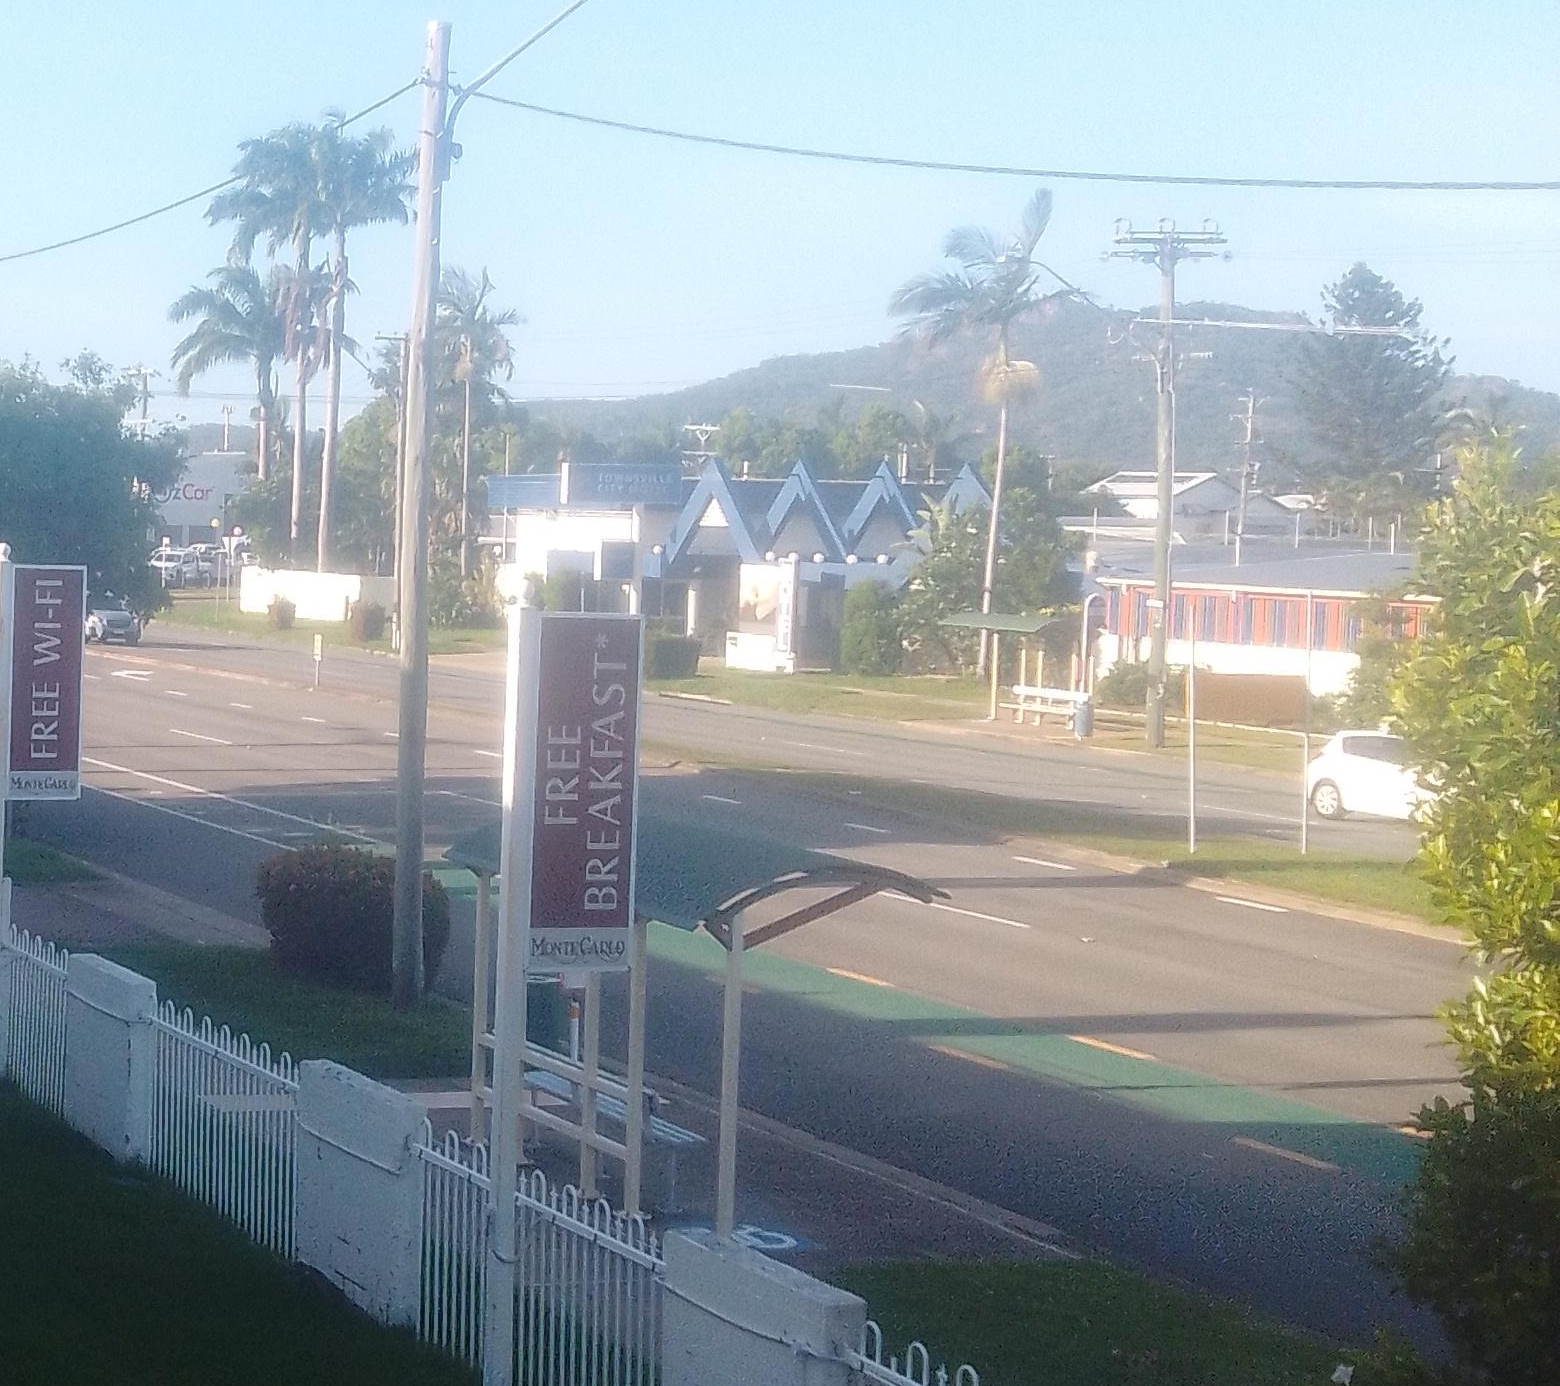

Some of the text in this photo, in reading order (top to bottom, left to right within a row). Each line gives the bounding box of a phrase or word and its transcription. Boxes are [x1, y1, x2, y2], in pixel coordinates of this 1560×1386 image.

[30, 579, 64, 760] FREE WI-FI
[544, 724, 582, 826] FREE
